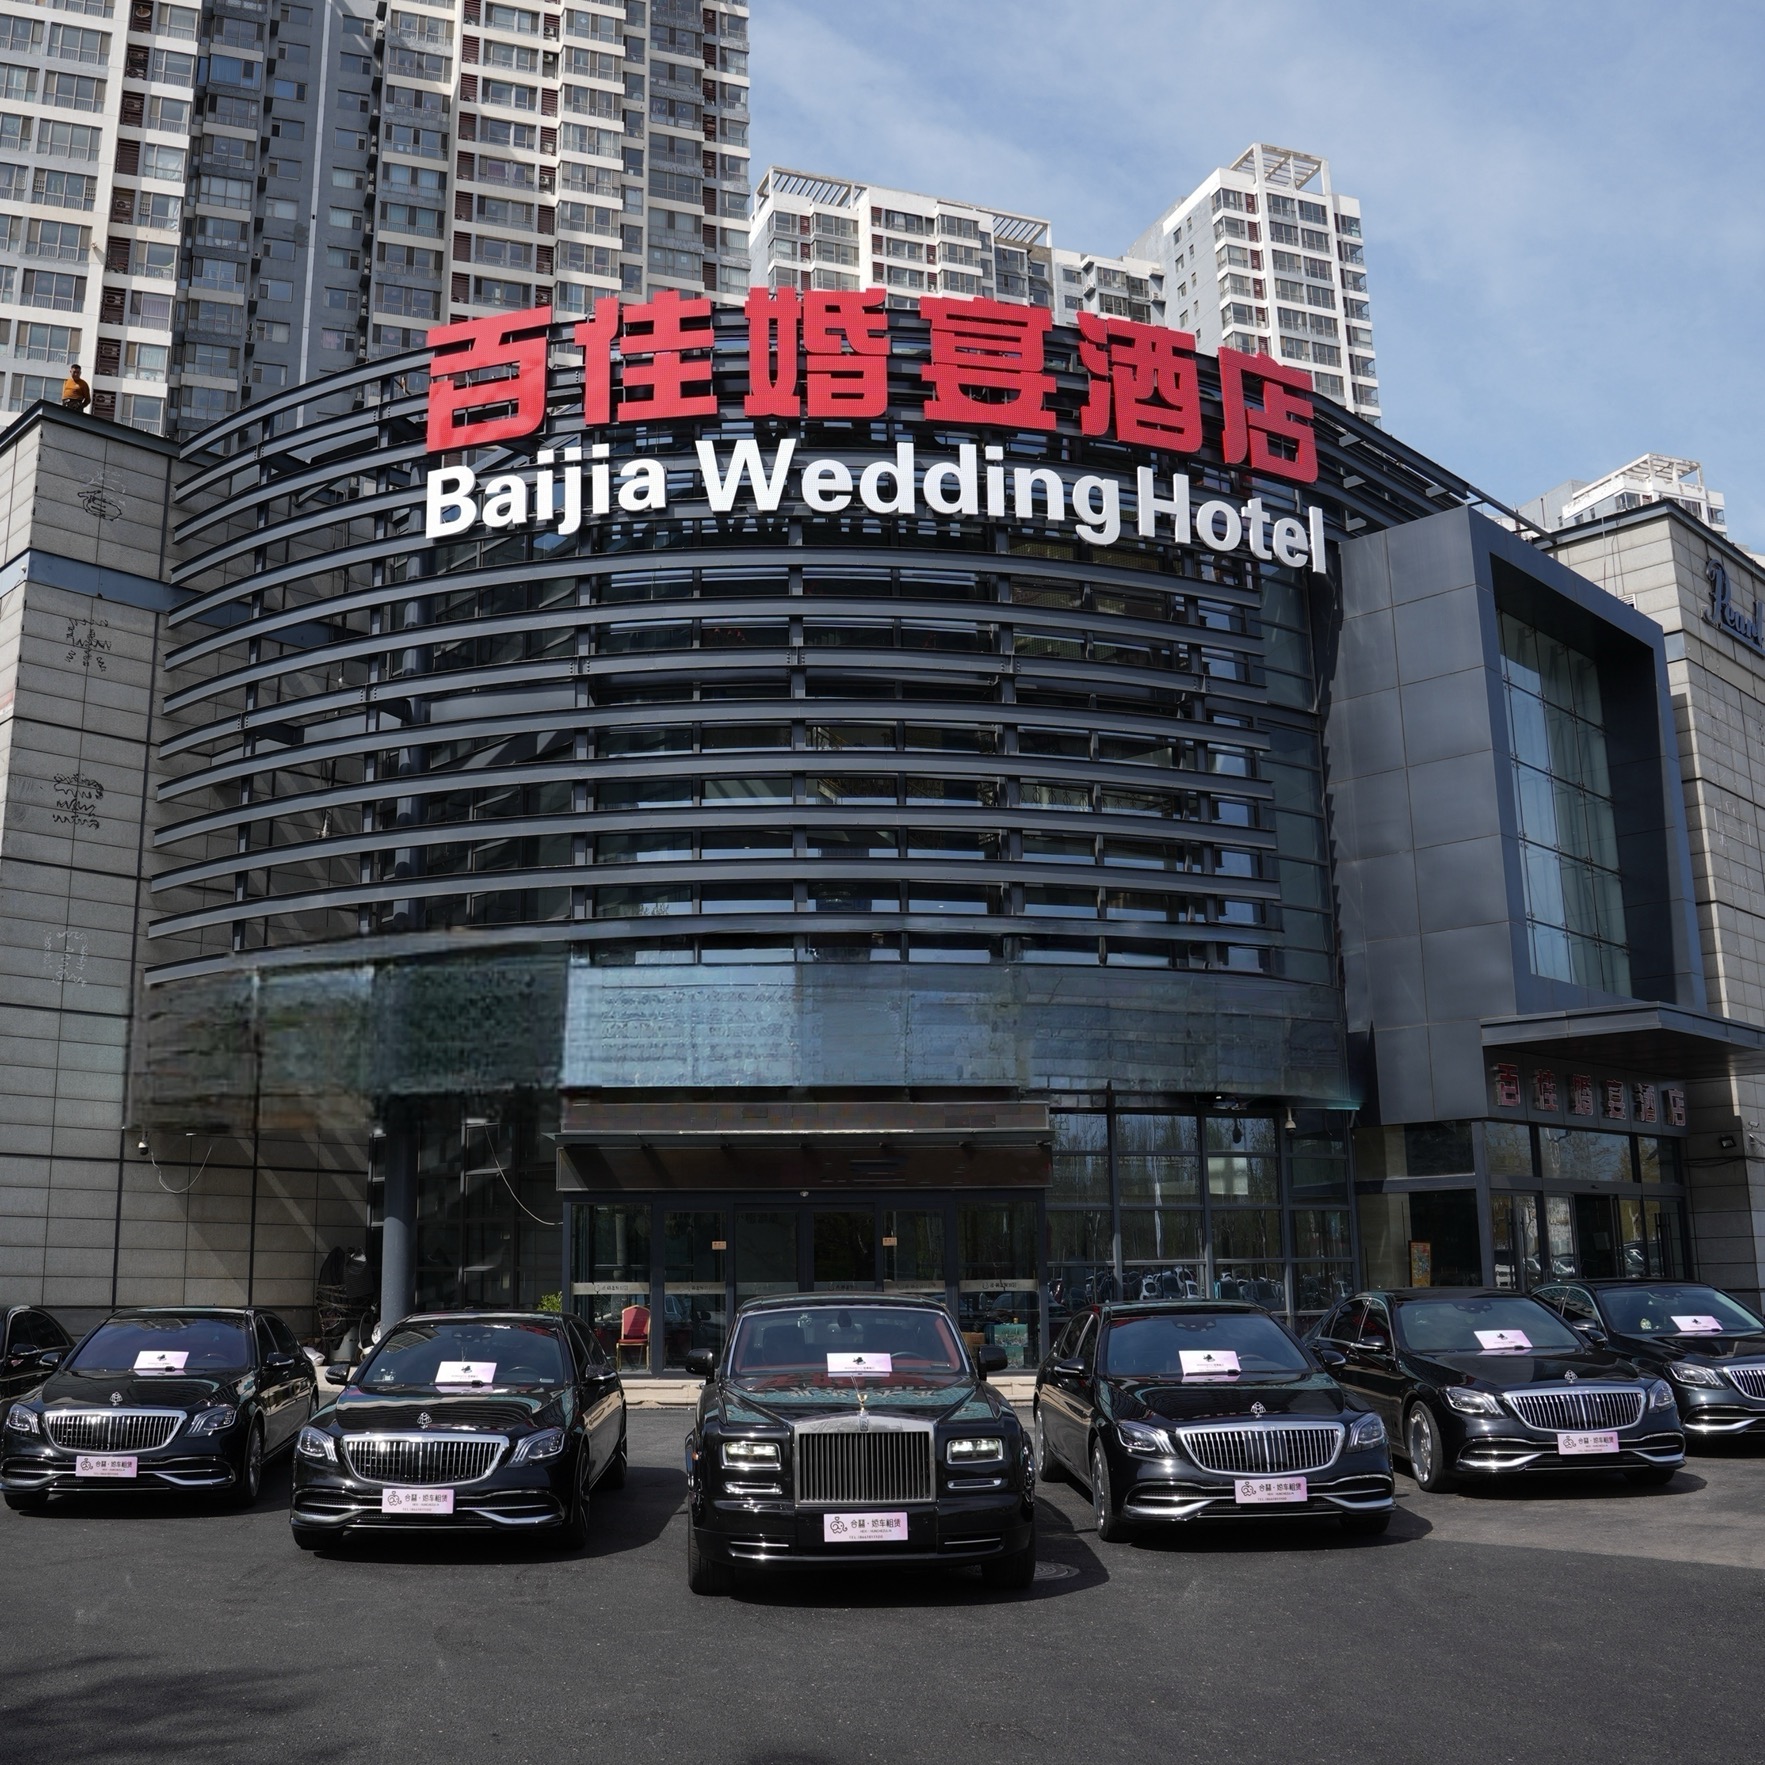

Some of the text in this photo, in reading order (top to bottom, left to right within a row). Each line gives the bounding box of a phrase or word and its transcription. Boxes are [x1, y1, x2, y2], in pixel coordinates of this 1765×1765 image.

[426, 286, 1318, 483] 百佳婚宴酒店
[425, 438, 1326, 575] Baijia Wedding Hotel
[1495, 1062, 1686, 1127] 百佳婚宴酒店
